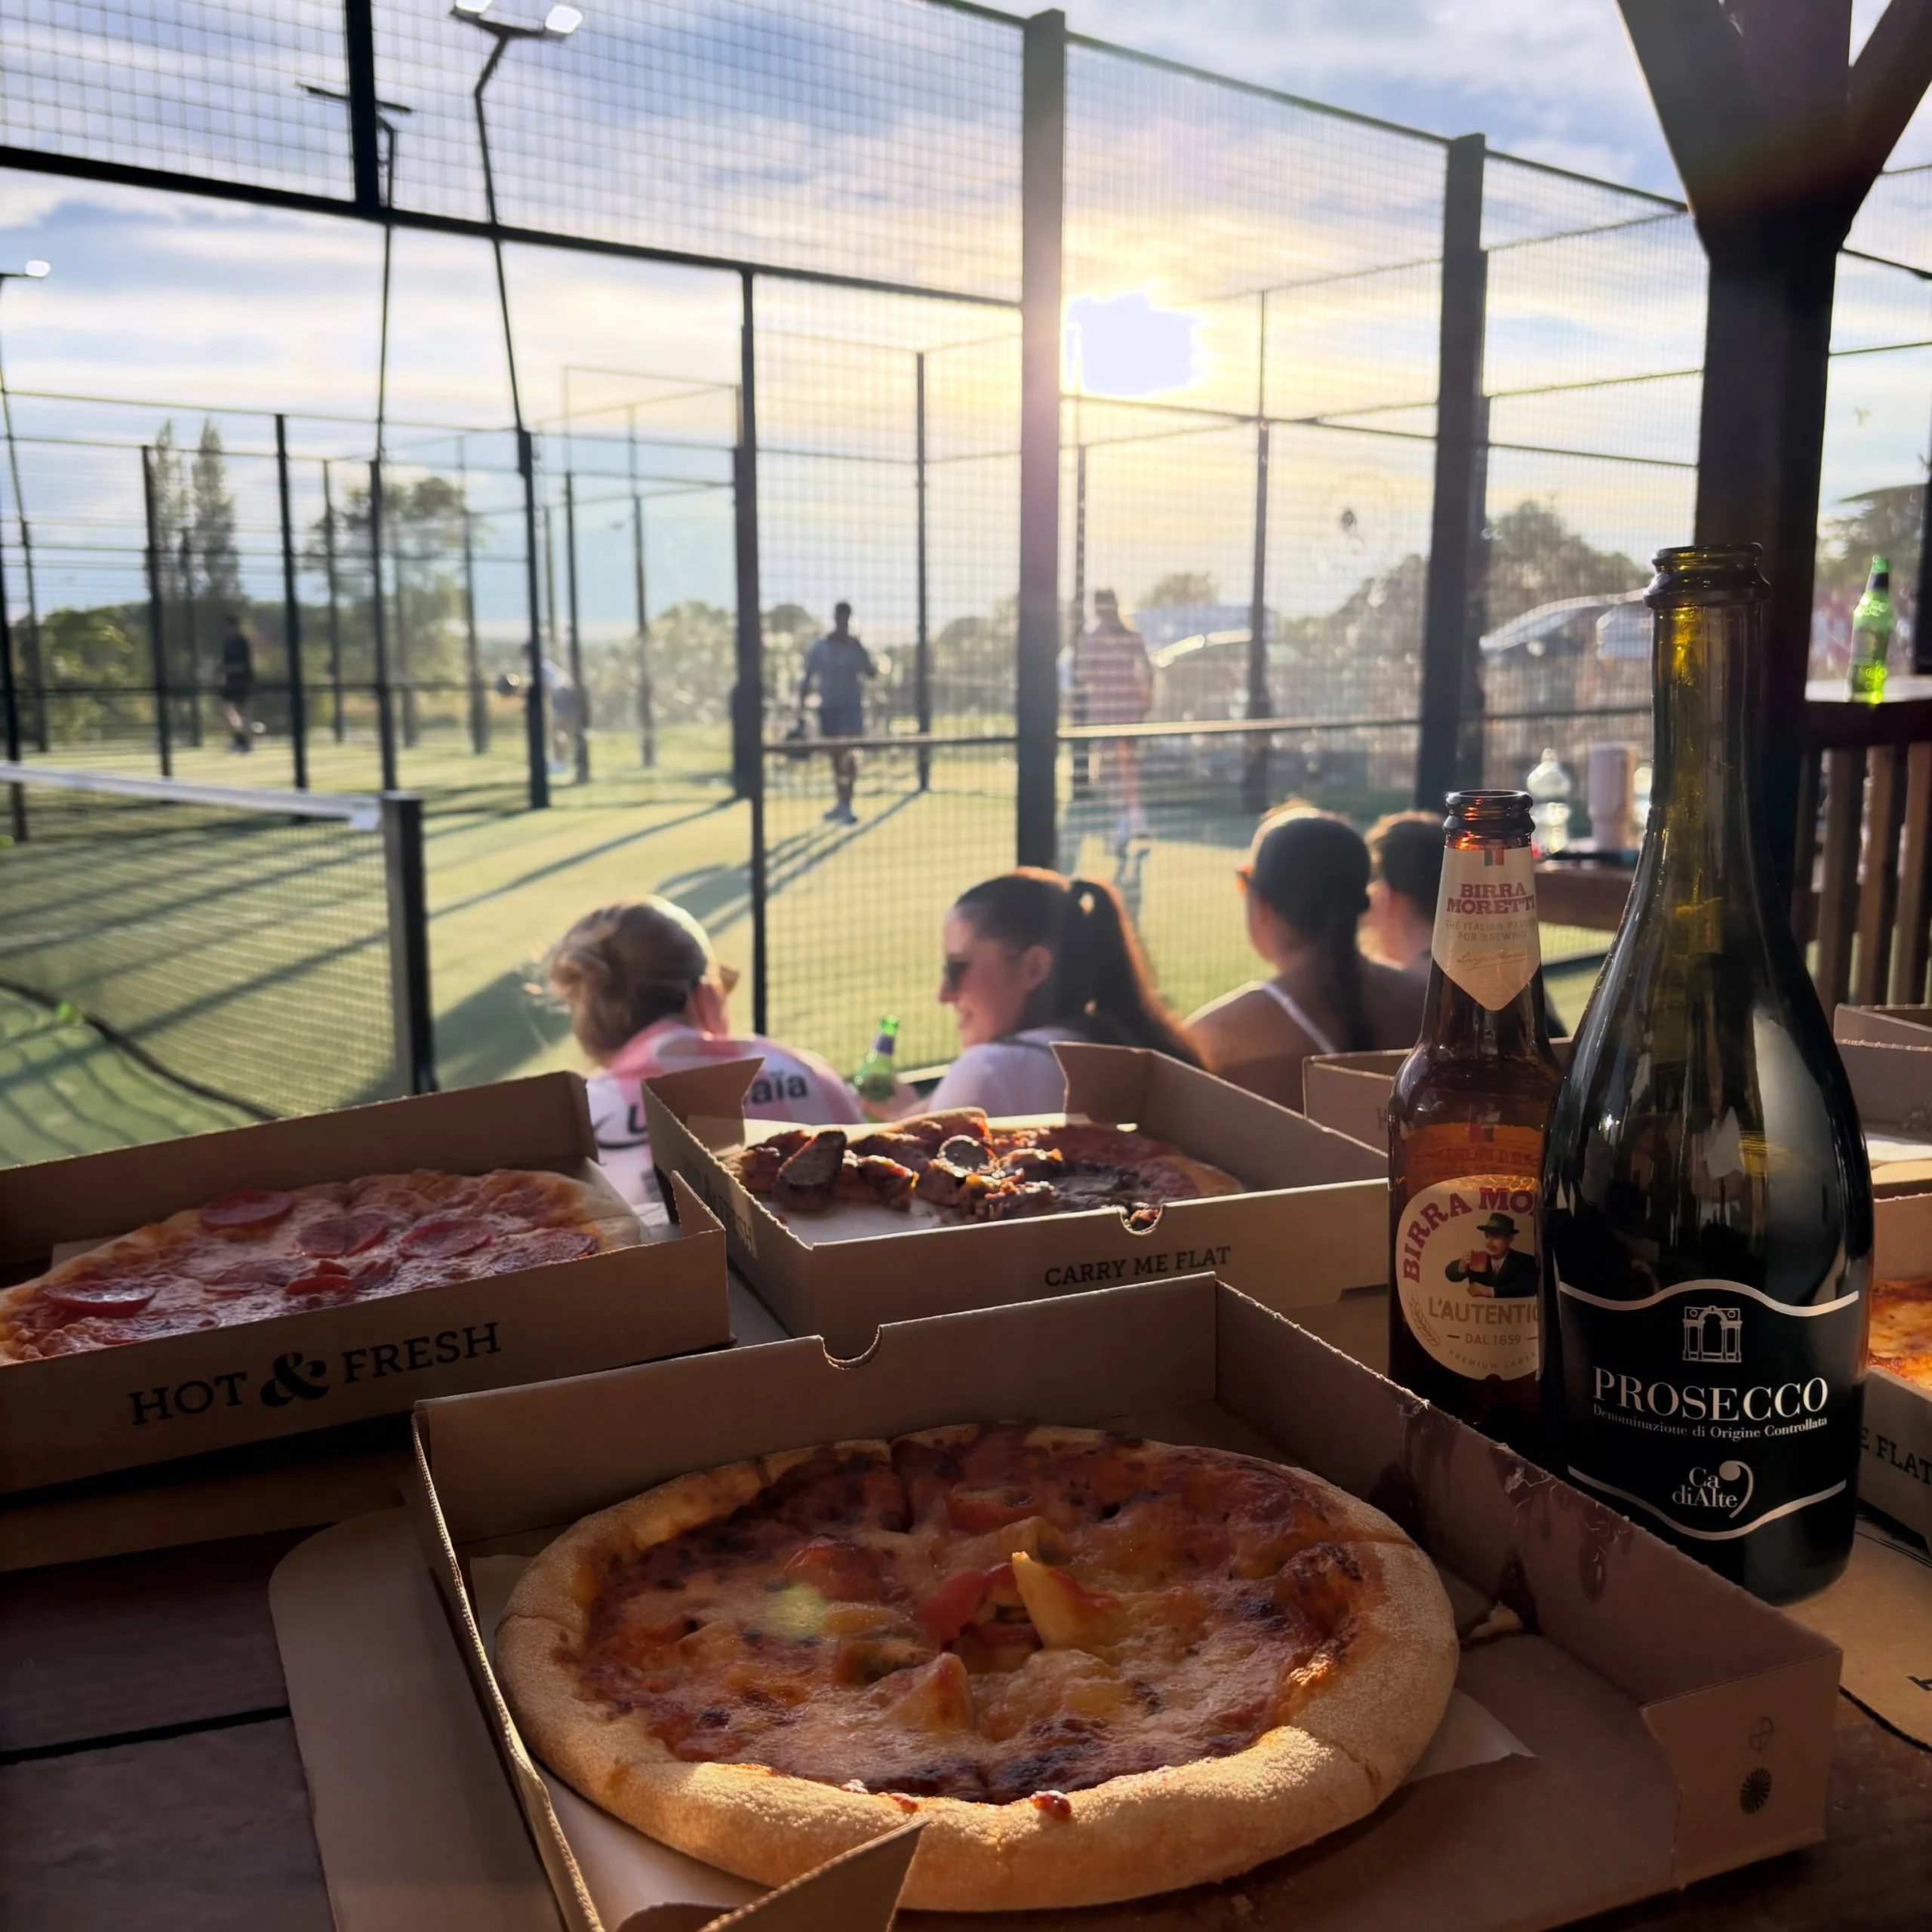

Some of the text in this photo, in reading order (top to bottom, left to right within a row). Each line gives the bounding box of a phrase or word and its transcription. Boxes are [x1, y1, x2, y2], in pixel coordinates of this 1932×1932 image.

[1460, 882, 1526, 898] BIRRA
[1446, 894, 1535, 915] MORETTI
[1458, 931, 1527, 942] FOR BREWING
[1464, 921, 1503, 931] ITALIAN
[1403, 1192, 1473, 1283] BIRRA
[1045, 1246, 1231, 1286] CARRY ME FLAT
[1465, 1333, 1521, 1346] DAL 1859
[1447, 1349, 1497, 1370] PREMIUM
[128, 1322, 501, 1426] HOT & FRESH
[1592, 1366, 1828, 1422] PROSECCO
[1593, 1404, 1828, 1442] Denominazione di Origine Controllata
[1876, 1434, 1932, 1486] FLAT
[1689, 1466, 1721, 1489] Ca
